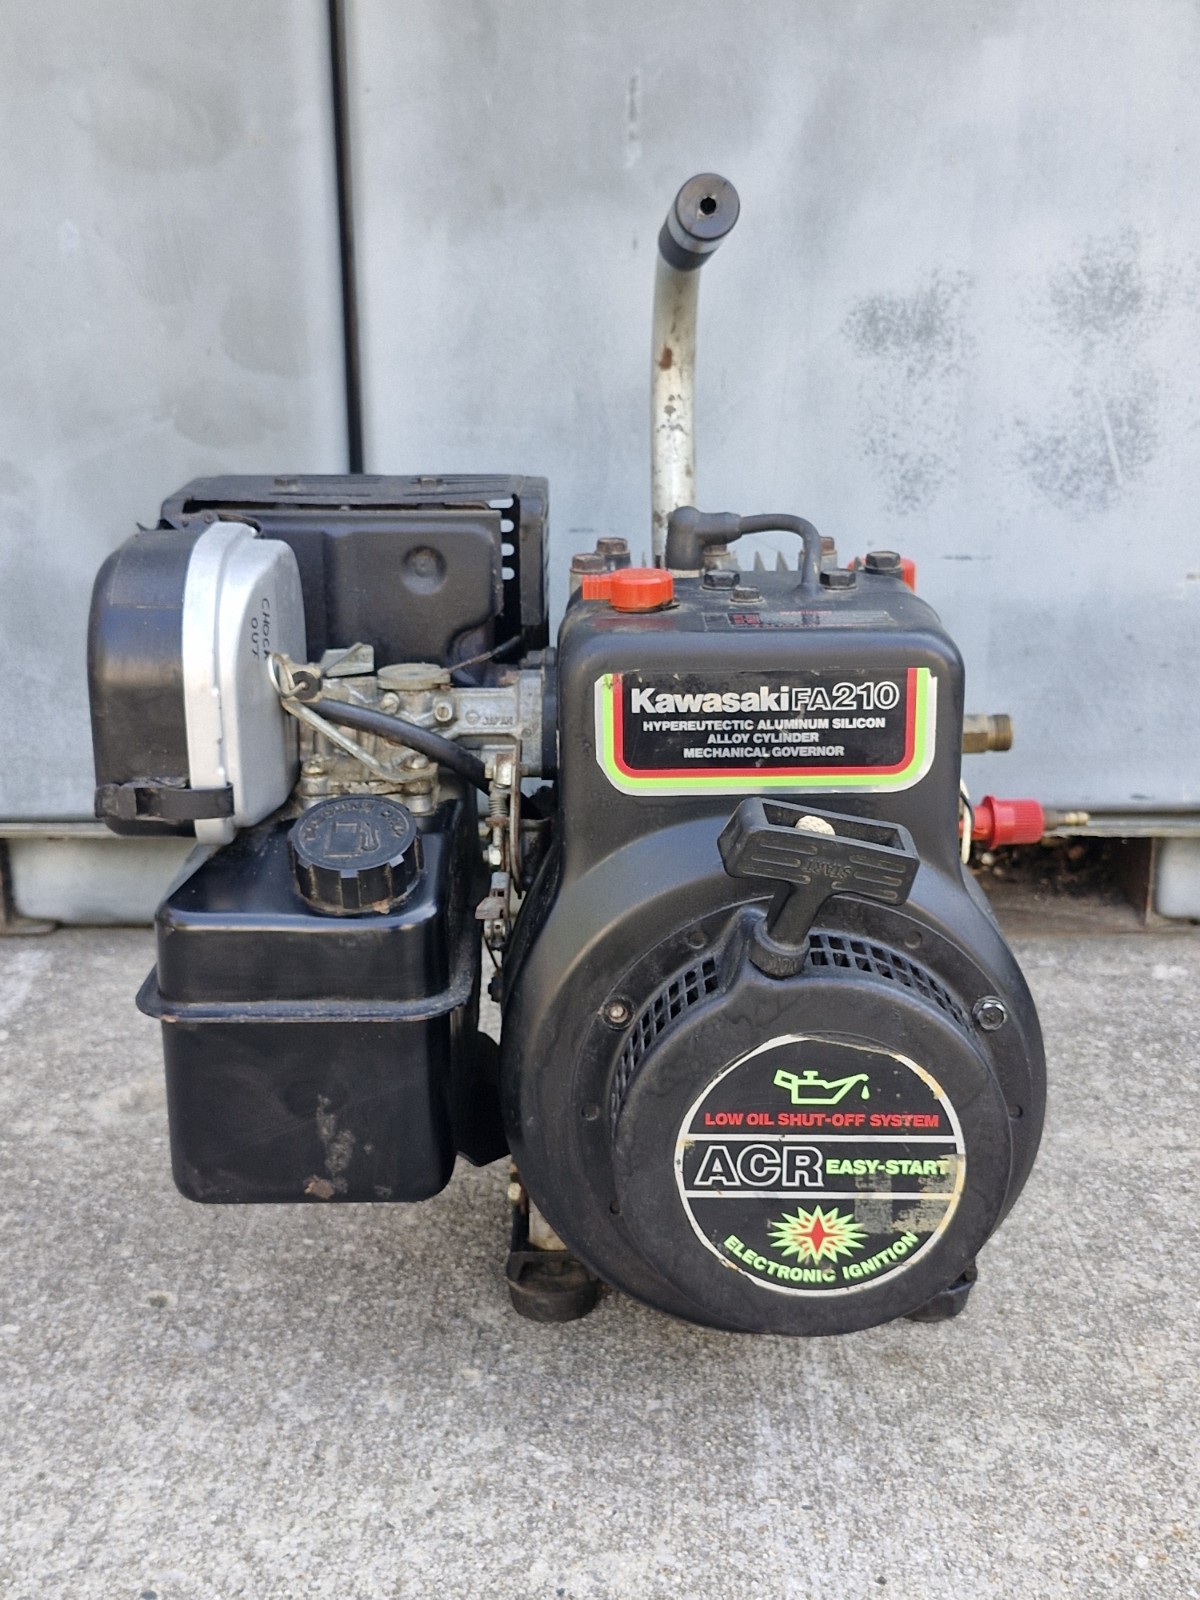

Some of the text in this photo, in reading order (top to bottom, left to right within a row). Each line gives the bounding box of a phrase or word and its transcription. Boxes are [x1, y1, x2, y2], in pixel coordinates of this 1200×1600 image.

[251, 617, 259, 660] OUT
[631, 681, 900, 714] Kawasaki FA210
[643, 717, 885, 732] HYPEREUTECTIC ALUMINUM SILICON
[707, 732, 819, 745] ALLOY CYLINDER
[683, 746, 844, 759] MECHANICAL GOVERNOR
[705, 1113, 939, 1127] LOW OIL SHUT-OFF SYSTEM
[693, 1143, 949, 1187] ACR EASY-START
[723, 1231, 919, 1283] ELECTRONIC IGNITION
